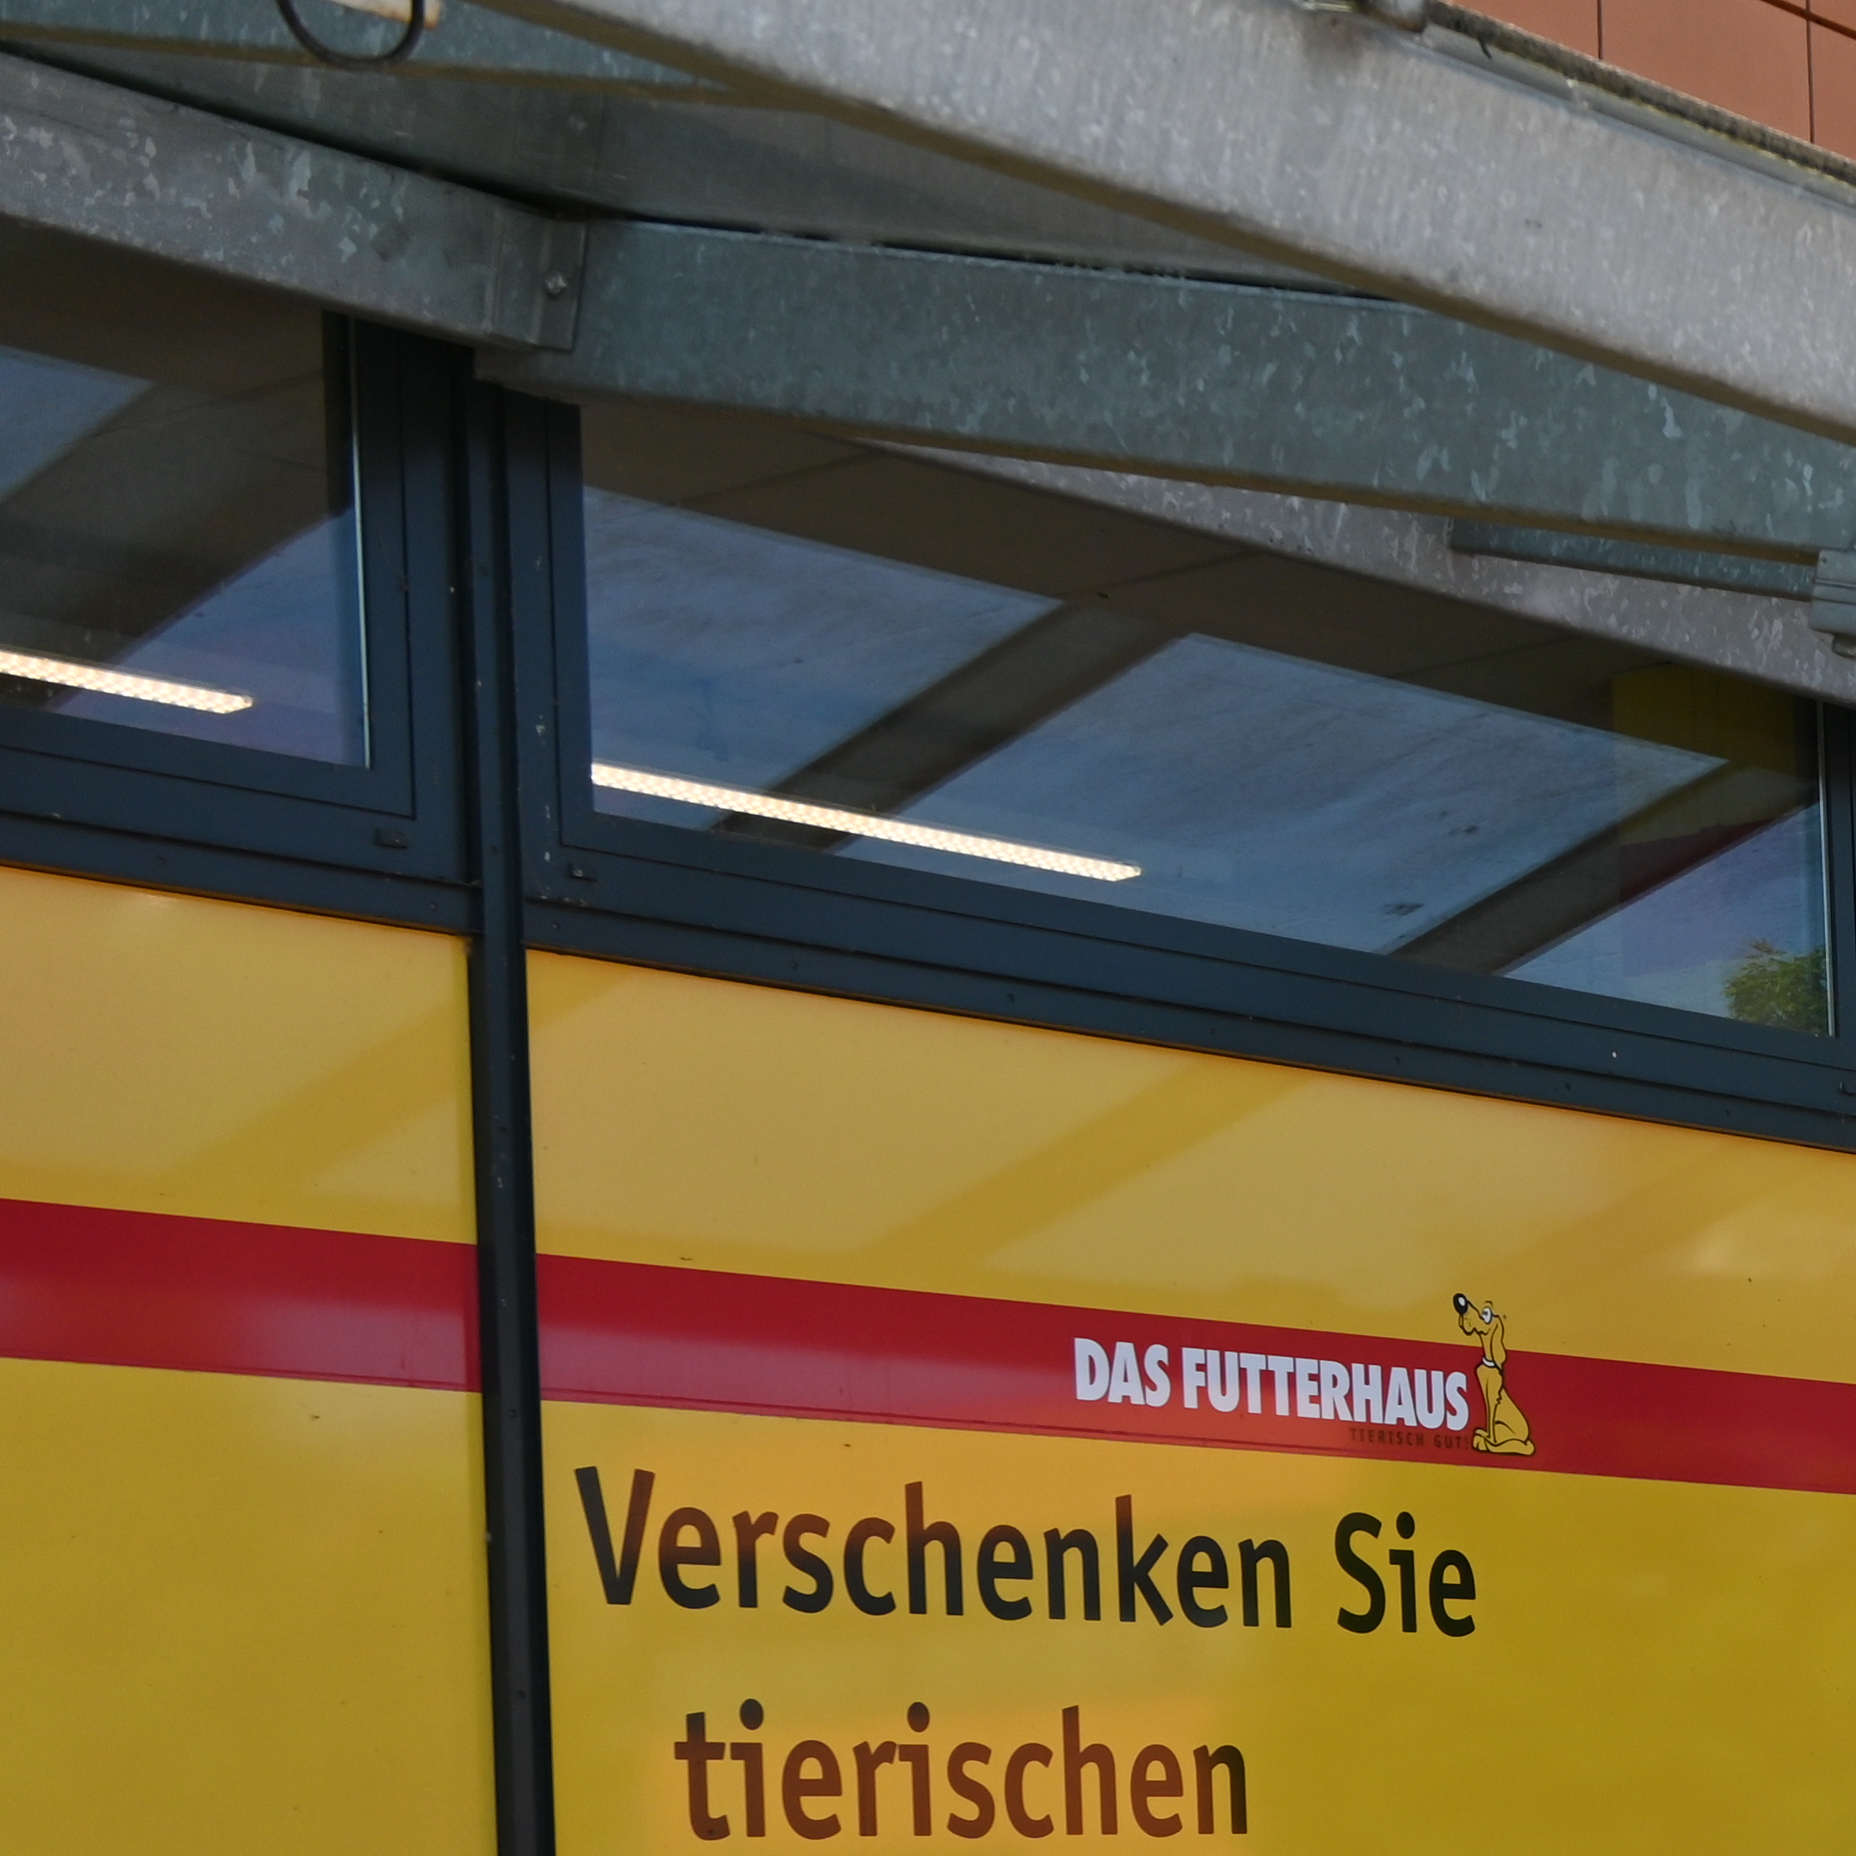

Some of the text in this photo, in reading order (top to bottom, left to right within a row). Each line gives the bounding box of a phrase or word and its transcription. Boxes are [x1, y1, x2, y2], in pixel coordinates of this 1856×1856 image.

[1074, 1337, 1469, 1431] DAS FUTTERHAUS
[1350, 1428, 1425, 1446] TIERISCH
[573, 1465, 1477, 1638] Verschenken Sie
[673, 1699, 1248, 1841] tierischen
